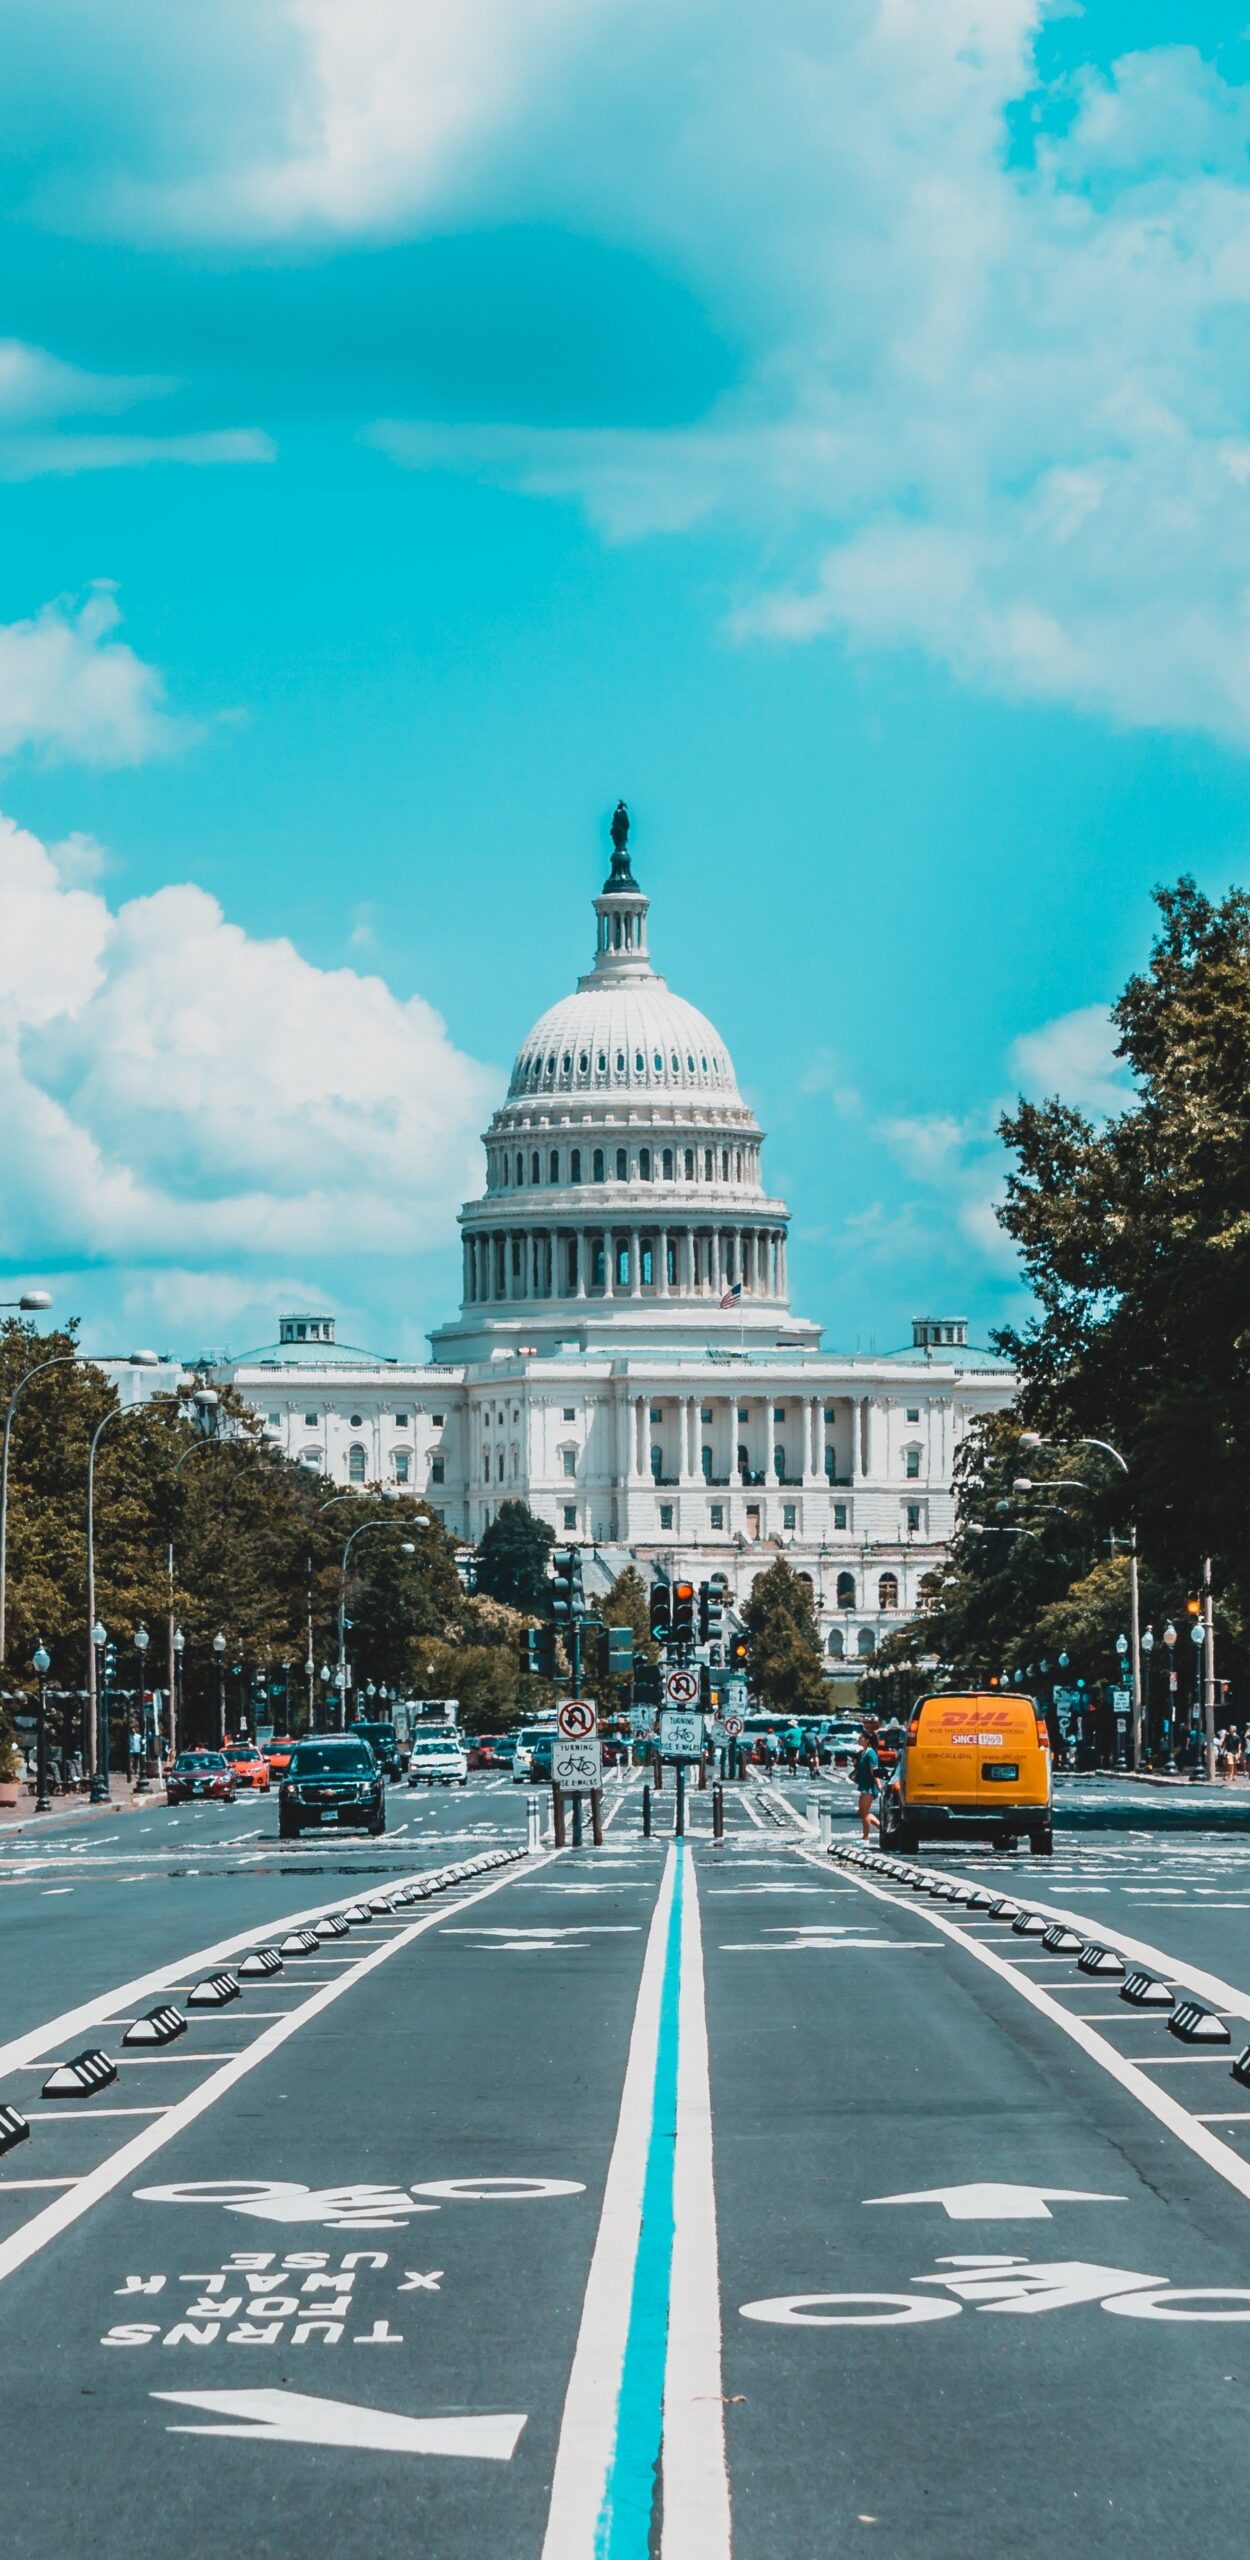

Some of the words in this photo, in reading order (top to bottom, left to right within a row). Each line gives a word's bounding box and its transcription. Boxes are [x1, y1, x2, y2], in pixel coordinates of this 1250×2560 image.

[669, 1717, 694, 1725] TURNING
[940, 1712, 1013, 1727] DHL
[952, 1735, 977, 1744] SINCE
[981, 1735, 1002, 1744] 1969
[220, 2251, 389, 2270] USE
[113, 2272, 356, 2295] WALK
[397, 2271, 444, 2290] X
[185, 2295, 352, 2318] FOR
[100, 2319, 404, 2345] TURNS
